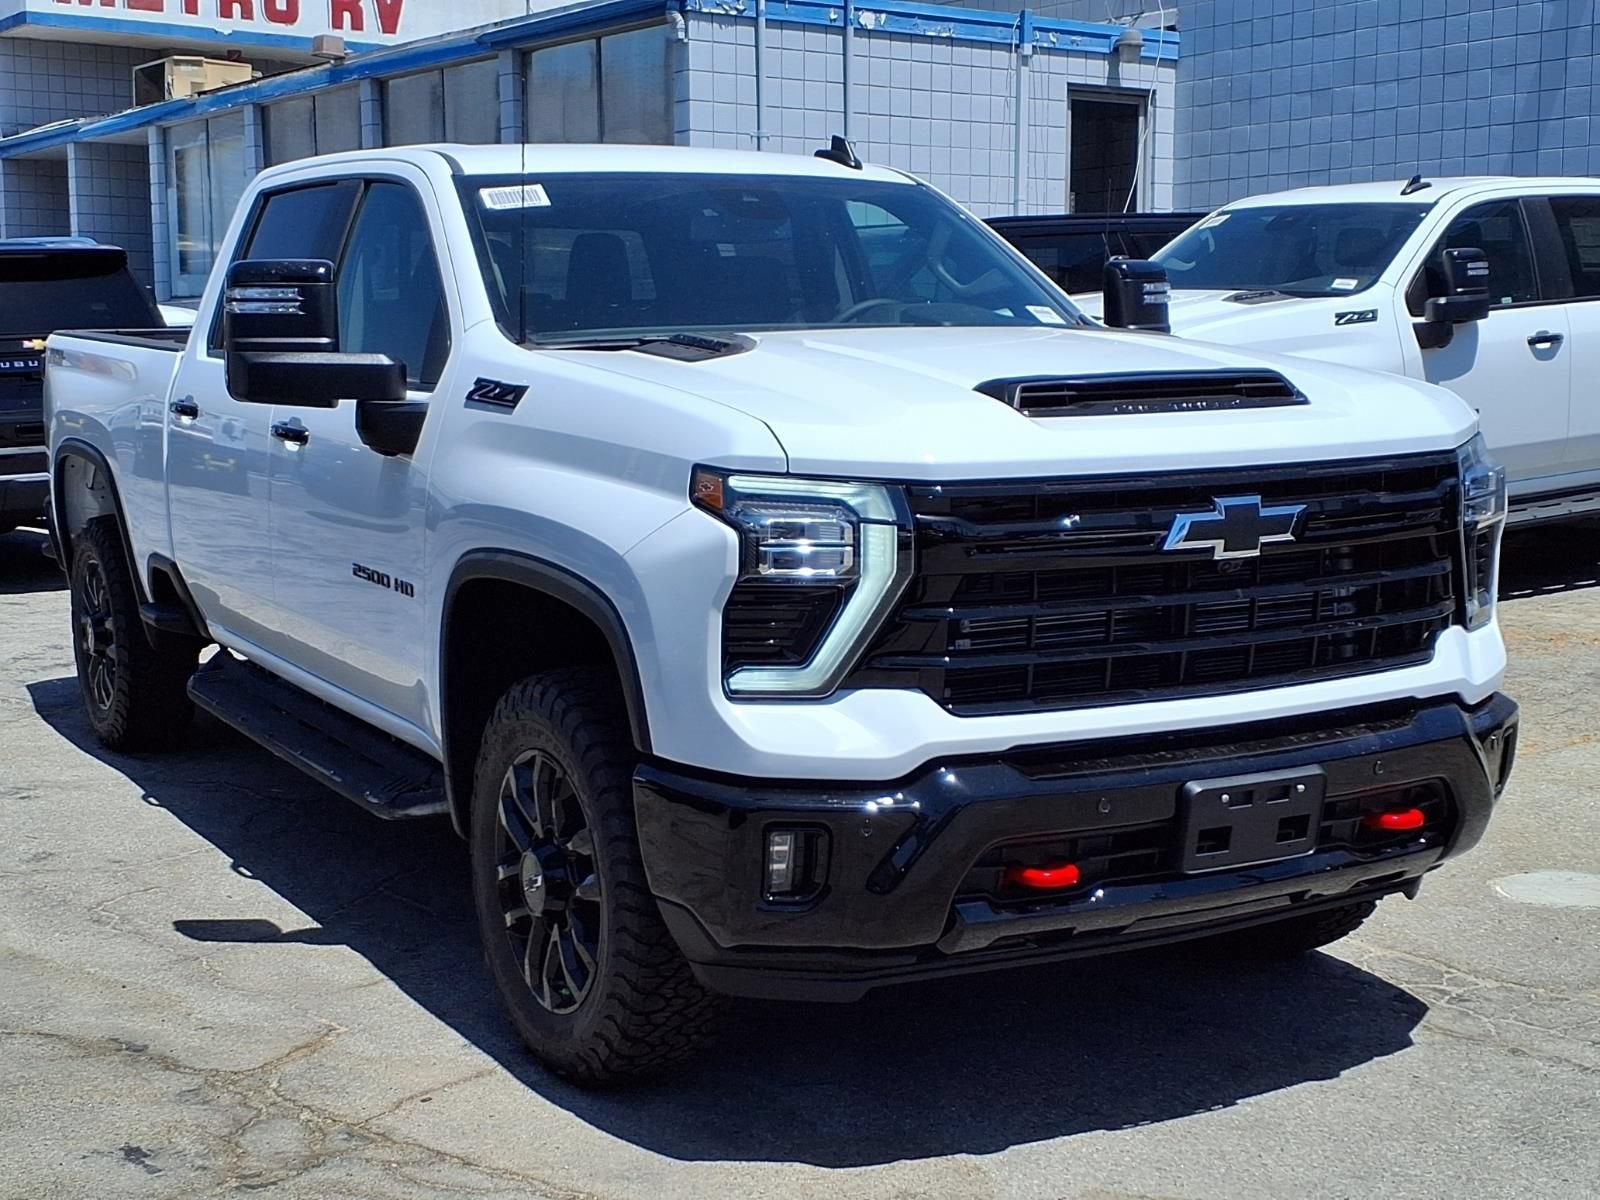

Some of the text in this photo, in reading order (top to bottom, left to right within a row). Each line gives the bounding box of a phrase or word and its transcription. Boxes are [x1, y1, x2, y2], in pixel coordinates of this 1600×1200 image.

[330, 0, 403, 34] RV
[352, 562, 415, 598] 2500 HD
